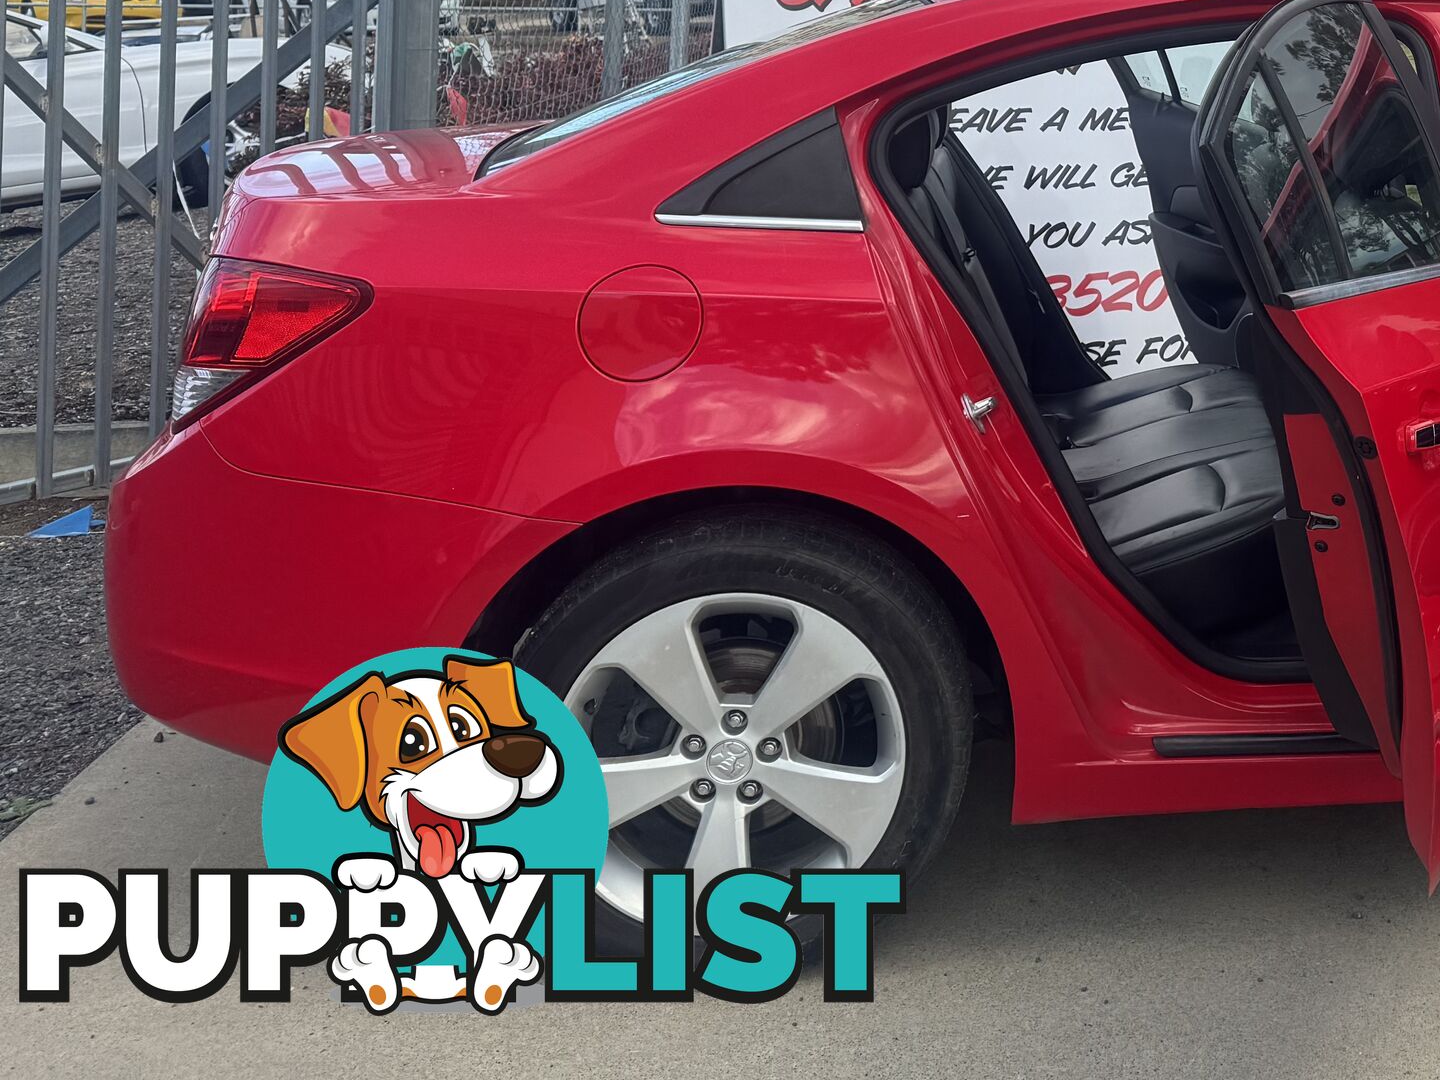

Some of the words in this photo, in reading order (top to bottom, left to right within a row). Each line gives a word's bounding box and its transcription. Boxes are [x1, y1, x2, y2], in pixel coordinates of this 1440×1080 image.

[949, 107, 1032, 133] EAVE
[1040, 107, 1069, 132] A
[1078, 107, 1131, 132] ME
[1023, 163, 1097, 190] WILL
[1110, 162, 1150, 188] GE
[1028, 221, 1096, 249] YOU
